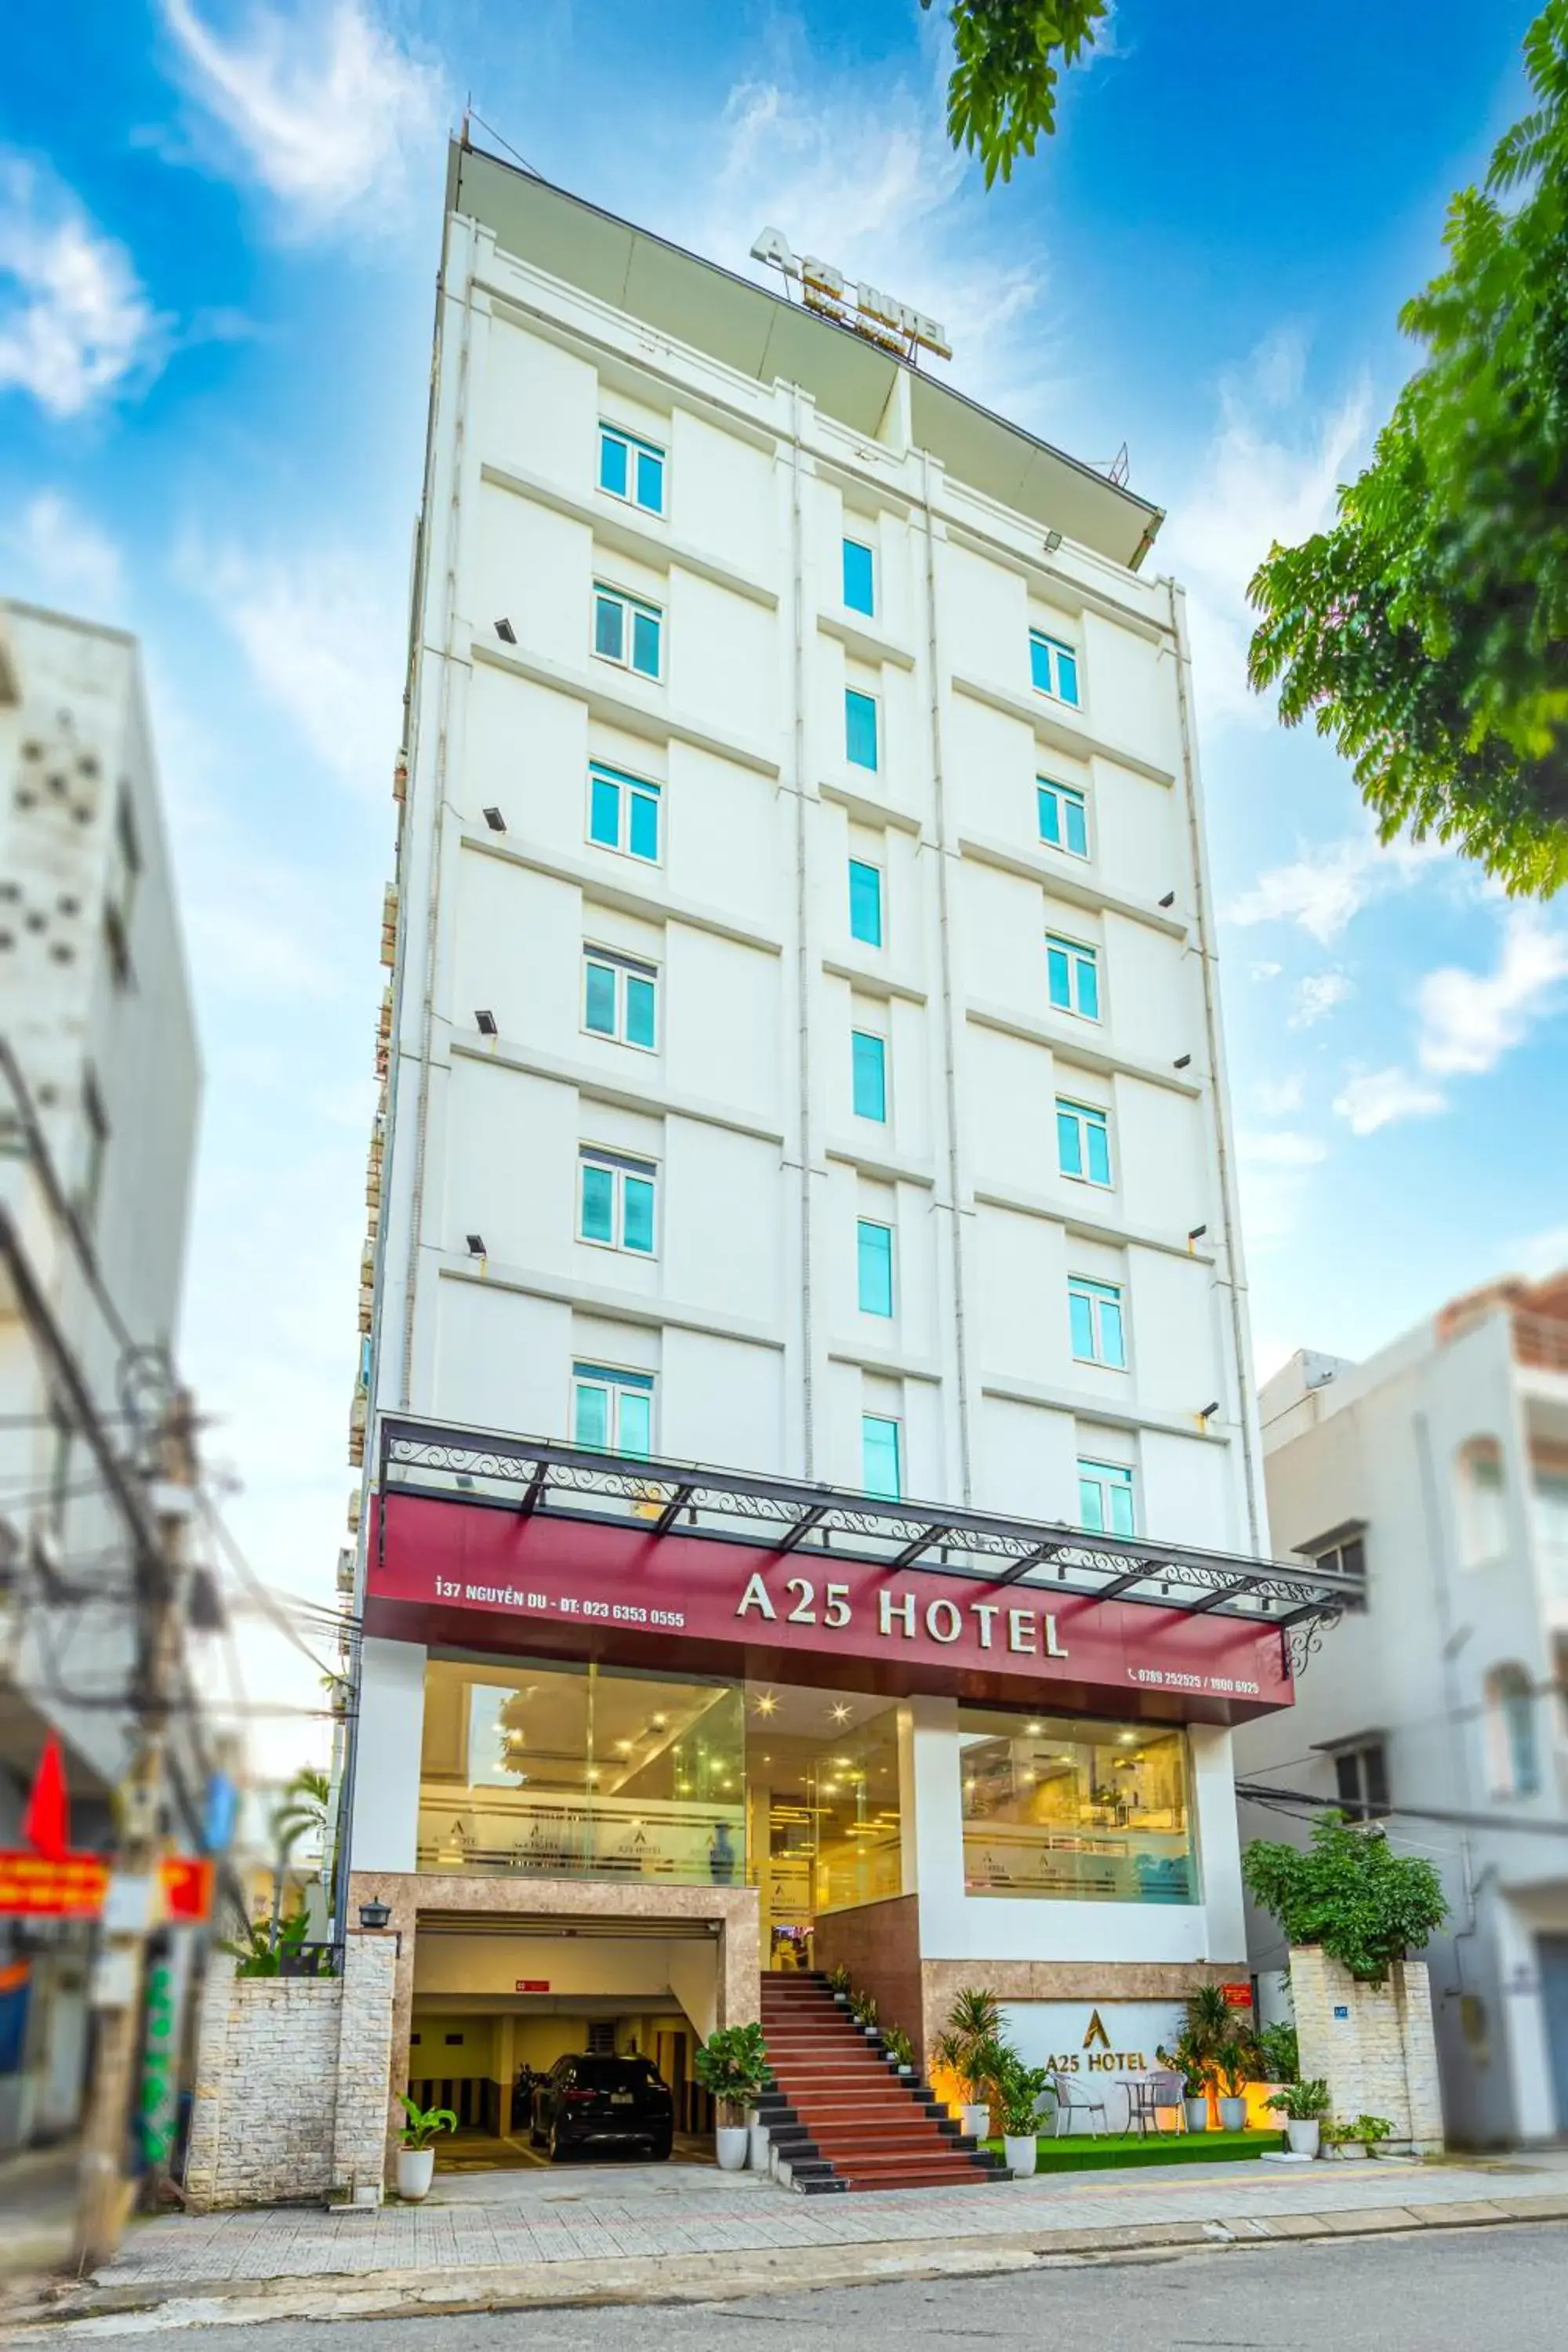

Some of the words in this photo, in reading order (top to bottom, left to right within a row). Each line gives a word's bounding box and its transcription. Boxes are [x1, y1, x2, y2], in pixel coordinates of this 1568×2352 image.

[583, 1600, 609, 1617] 023
[612, 1604, 647, 1623] 6353
[650, 1609, 684, 1628] 0555
[735, 1572, 852, 1628] A25
[877, 1588, 1069, 1657] HOTEL
[1044, 2053, 1080, 2073] A25
[1087, 2053, 1148, 2072] HOTEL
